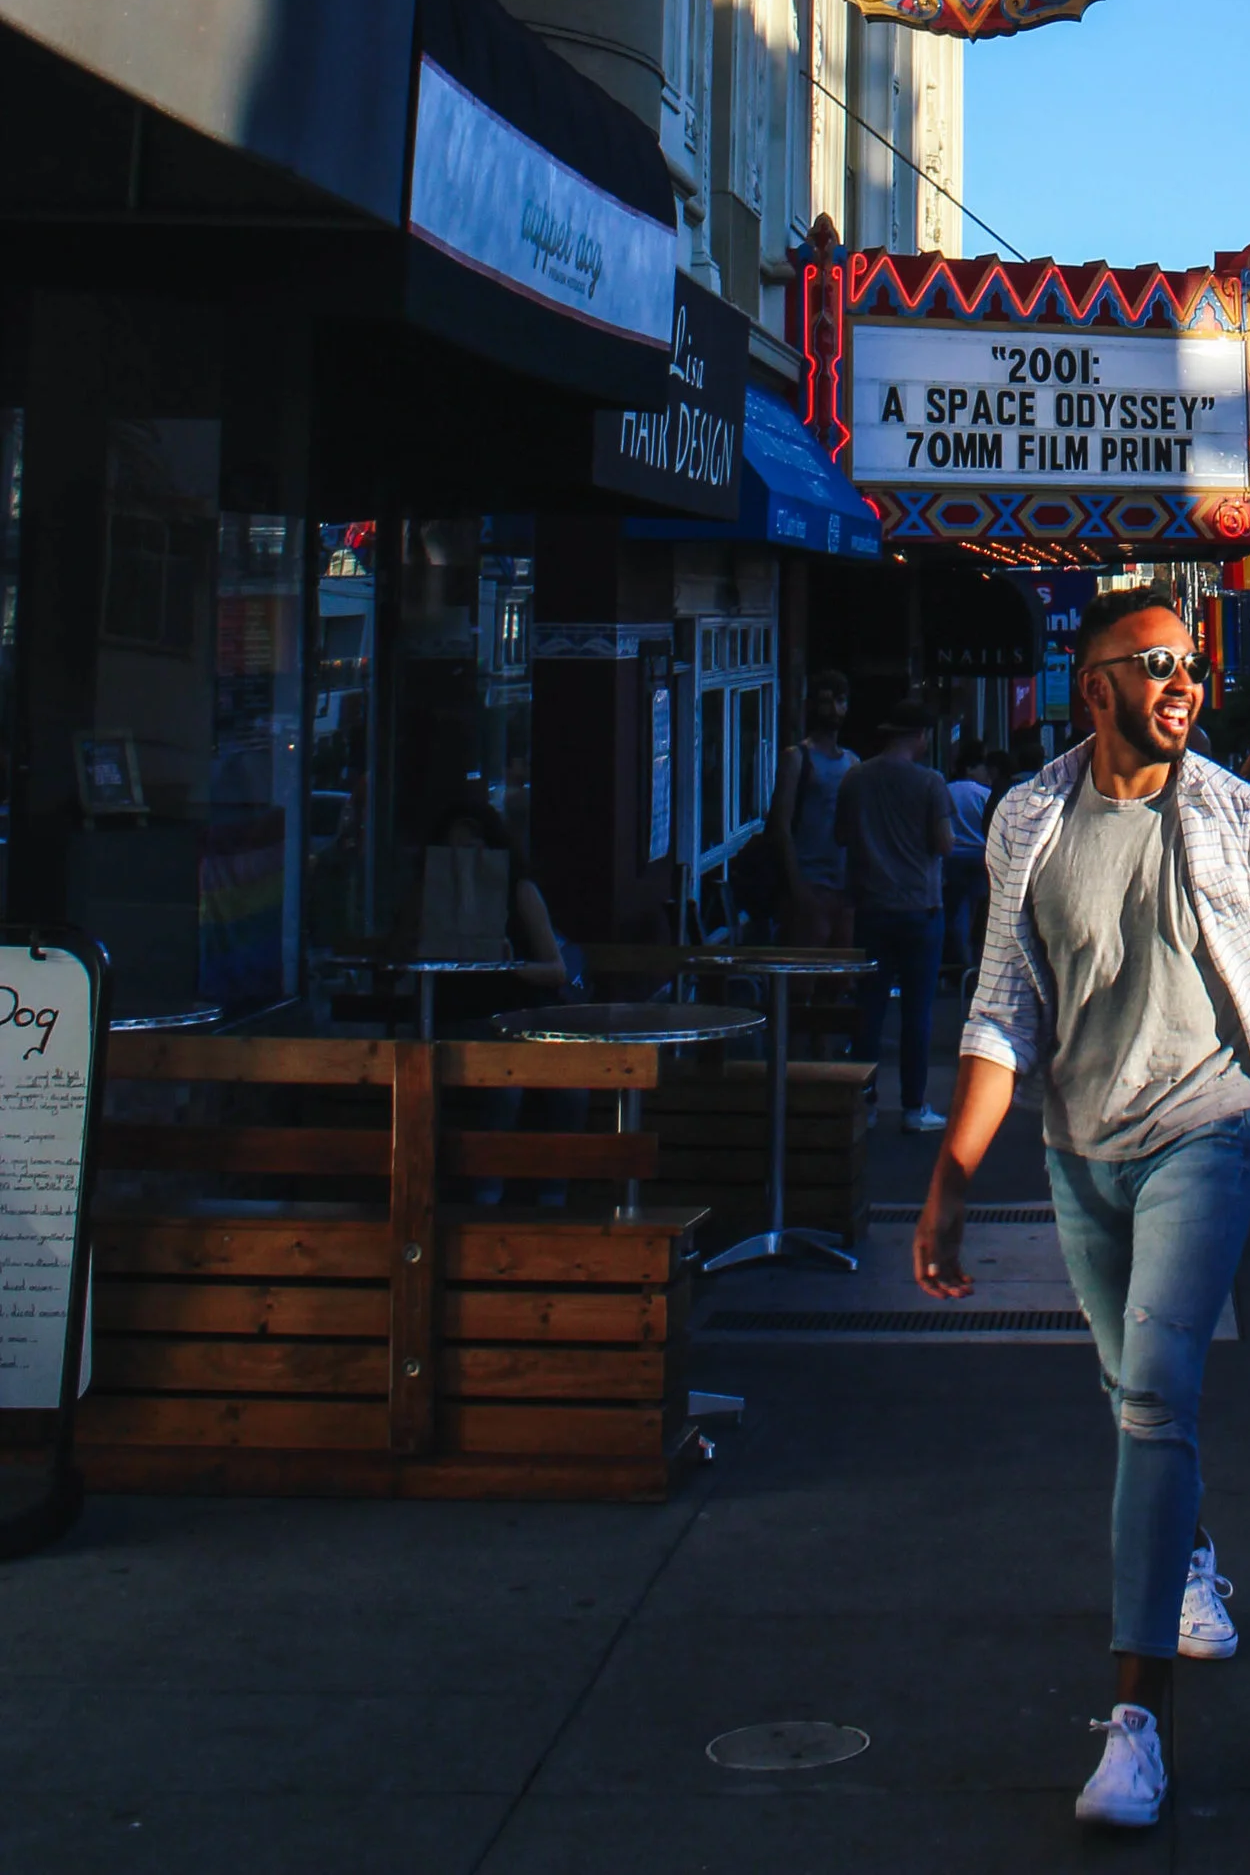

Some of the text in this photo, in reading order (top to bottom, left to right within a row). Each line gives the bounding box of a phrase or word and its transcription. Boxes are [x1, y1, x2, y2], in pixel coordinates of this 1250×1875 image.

[669, 303, 705, 389] Lisa
[881, 386, 904, 423] A
[926, 387, 1036, 426] SPACE
[620, 402, 735, 487] HAIR DESIGN
[906, 432, 1192, 473] 70MM FILM PRINT
[937, 647, 1025, 666] NAILS
